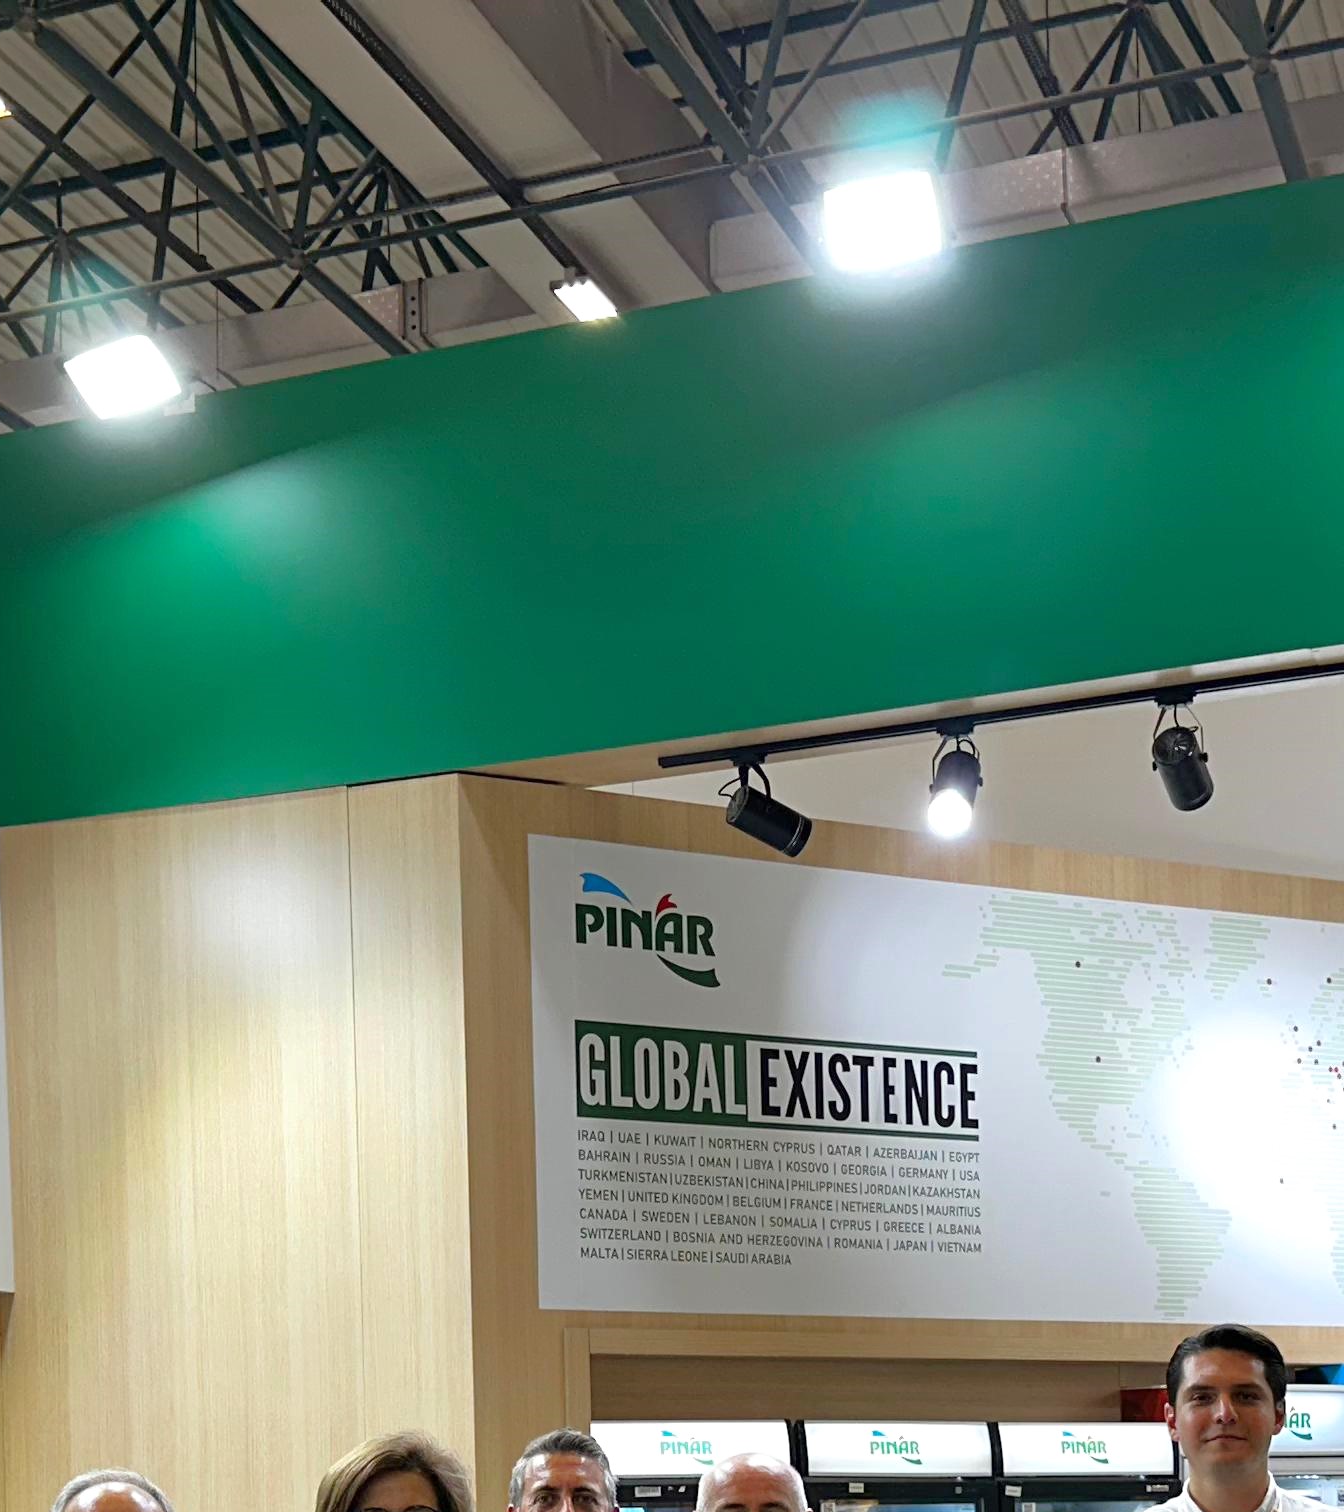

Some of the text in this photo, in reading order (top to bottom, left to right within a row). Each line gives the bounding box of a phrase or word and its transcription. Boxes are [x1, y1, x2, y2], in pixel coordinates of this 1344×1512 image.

[575, 904, 715, 956] PINAR
[578, 1033, 979, 1129] GLOBAL EXISTENCE
[578, 1130, 605, 1142] IRAQ
[618, 1133, 641, 1144] UAE
[654, 1135, 696, 1147] KUWAIT
[709, 1138, 768, 1151] NORTHERN
[773, 1141, 815, 1154] CYPRUS
[827, 1145, 861, 1157] QATAR
[949, 1151, 980, 1163] EGYPT
[578, 1150, 980, 1181] BAHRAIN RUSSIA OMAN LIBYA KOSOVO GEORGIA GERMANY USA
[578, 1169, 980, 1199] TURKMENISTAN UZBEKISTAN CHINA PHILIPPINES JORDAN KAZAKHSTAN
[579, 1189, 981, 1217] YEMEN UNITED KINGDOM BELGIUM FRANCE NETHERLANDS MAURITIUS
[579, 1208, 981, 1235] CANADA SWEDEN LEBANON SOMALIA CYPRUS GREECE ALBANIA
[580, 1227, 981, 1253] SWITZERLAND BOSNIA AND HERZEGOVINA ROMANIA JAPAN VIETNAM
[580, 1248, 792, 1265] MALTA SIERRA LEONE SAUDI ARABIA
